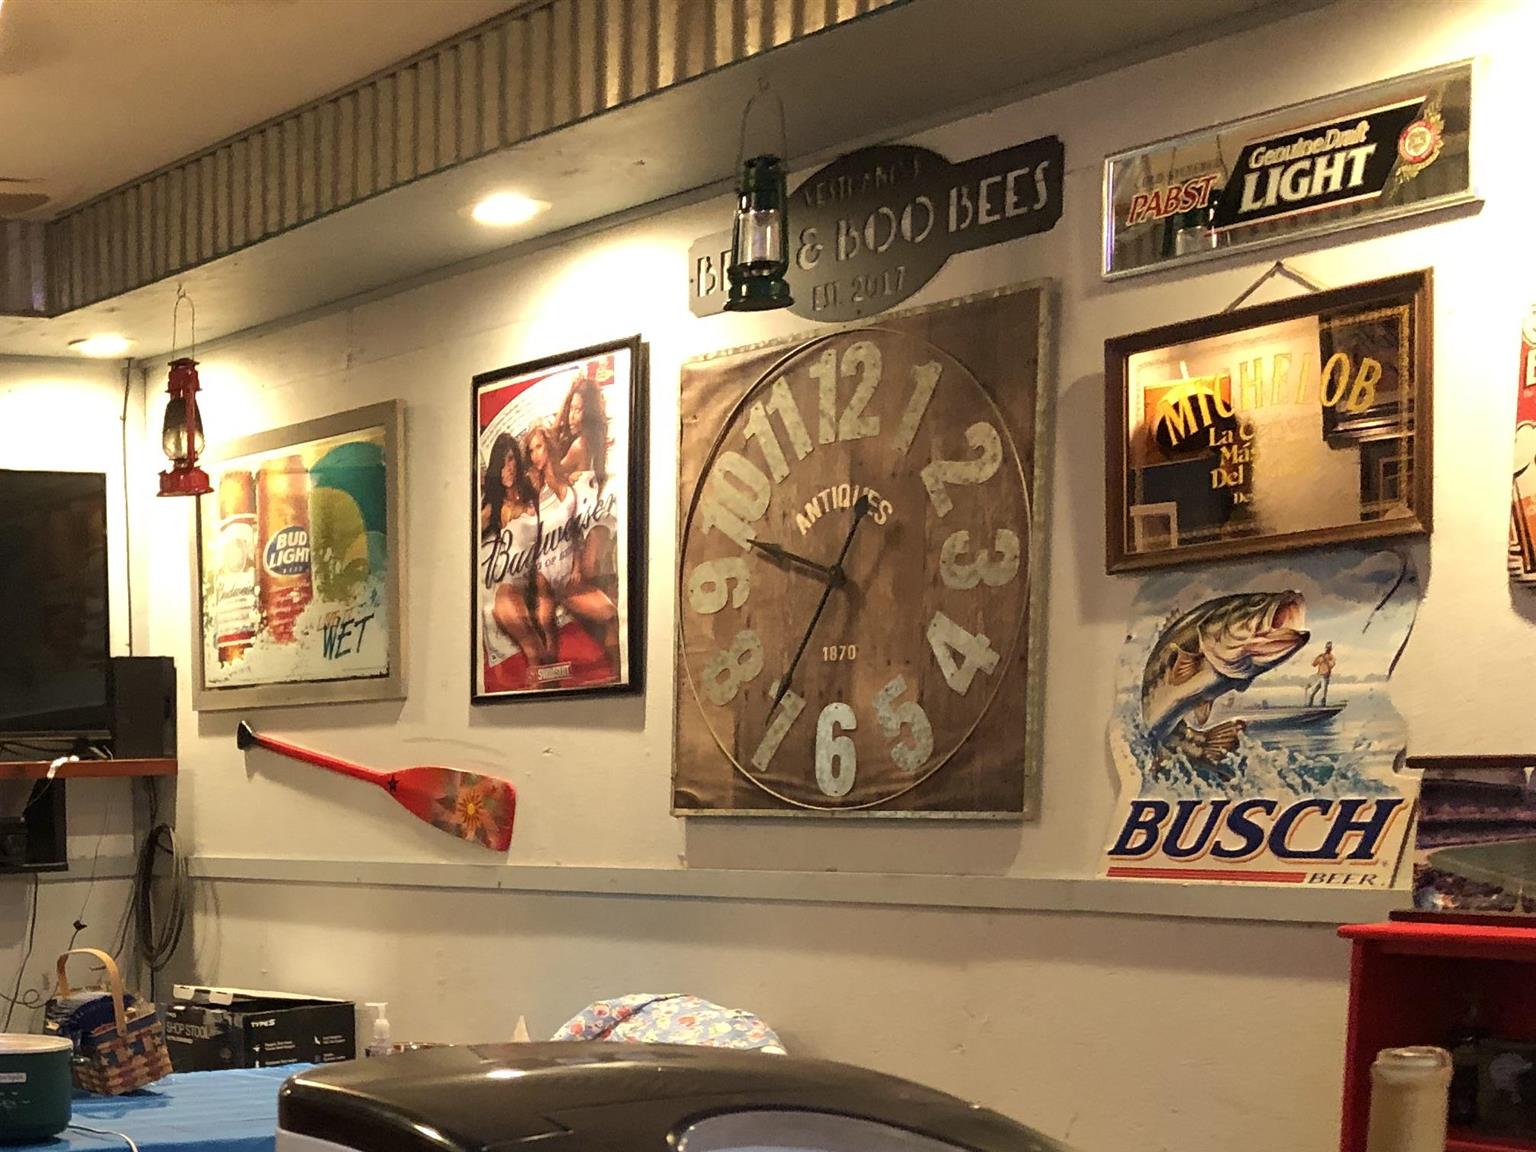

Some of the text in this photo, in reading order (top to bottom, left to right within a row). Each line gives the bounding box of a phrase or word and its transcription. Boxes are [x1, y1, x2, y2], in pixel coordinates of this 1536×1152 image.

[1239, 144, 1377, 213] LIGHT
[1249, 120, 1371, 169] Genuine Draft
[795, 227, 824, 270] &
[838, 196, 934, 261] BOO
[948, 160, 1049, 233] BEES
[1126, 174, 1220, 226] PABST
[852, 266, 906, 302] 2017
[810, 341, 882, 445] 12
[892, 360, 943, 456] 1
[1159, 352, 1383, 447] MICHELOB
[743, 376, 815, 484] 11
[1208, 427, 1234, 447] La
[701, 451, 771, 552] 10
[920, 421, 1002, 517] 2
[1210, 465, 1244, 489] Del
[269, 547, 311, 567] LIGHT
[276, 530, 308, 550] BUD
[481, 492, 617, 590] Budweiser
[939, 528, 1020, 590] 3
[689, 556, 751, 614] 9
[322, 612, 375, 660] WET
[701, 630, 764, 707] 8
[822, 645, 857, 661] 1870
[926, 610, 1000, 696] 4
[751, 679, 807, 772] 7
[815, 702, 857, 797] 6
[872, 674, 934, 772] 5
[1107, 798, 1407, 865] BUSCH
[1307, 871, 1378, 887] BEER
